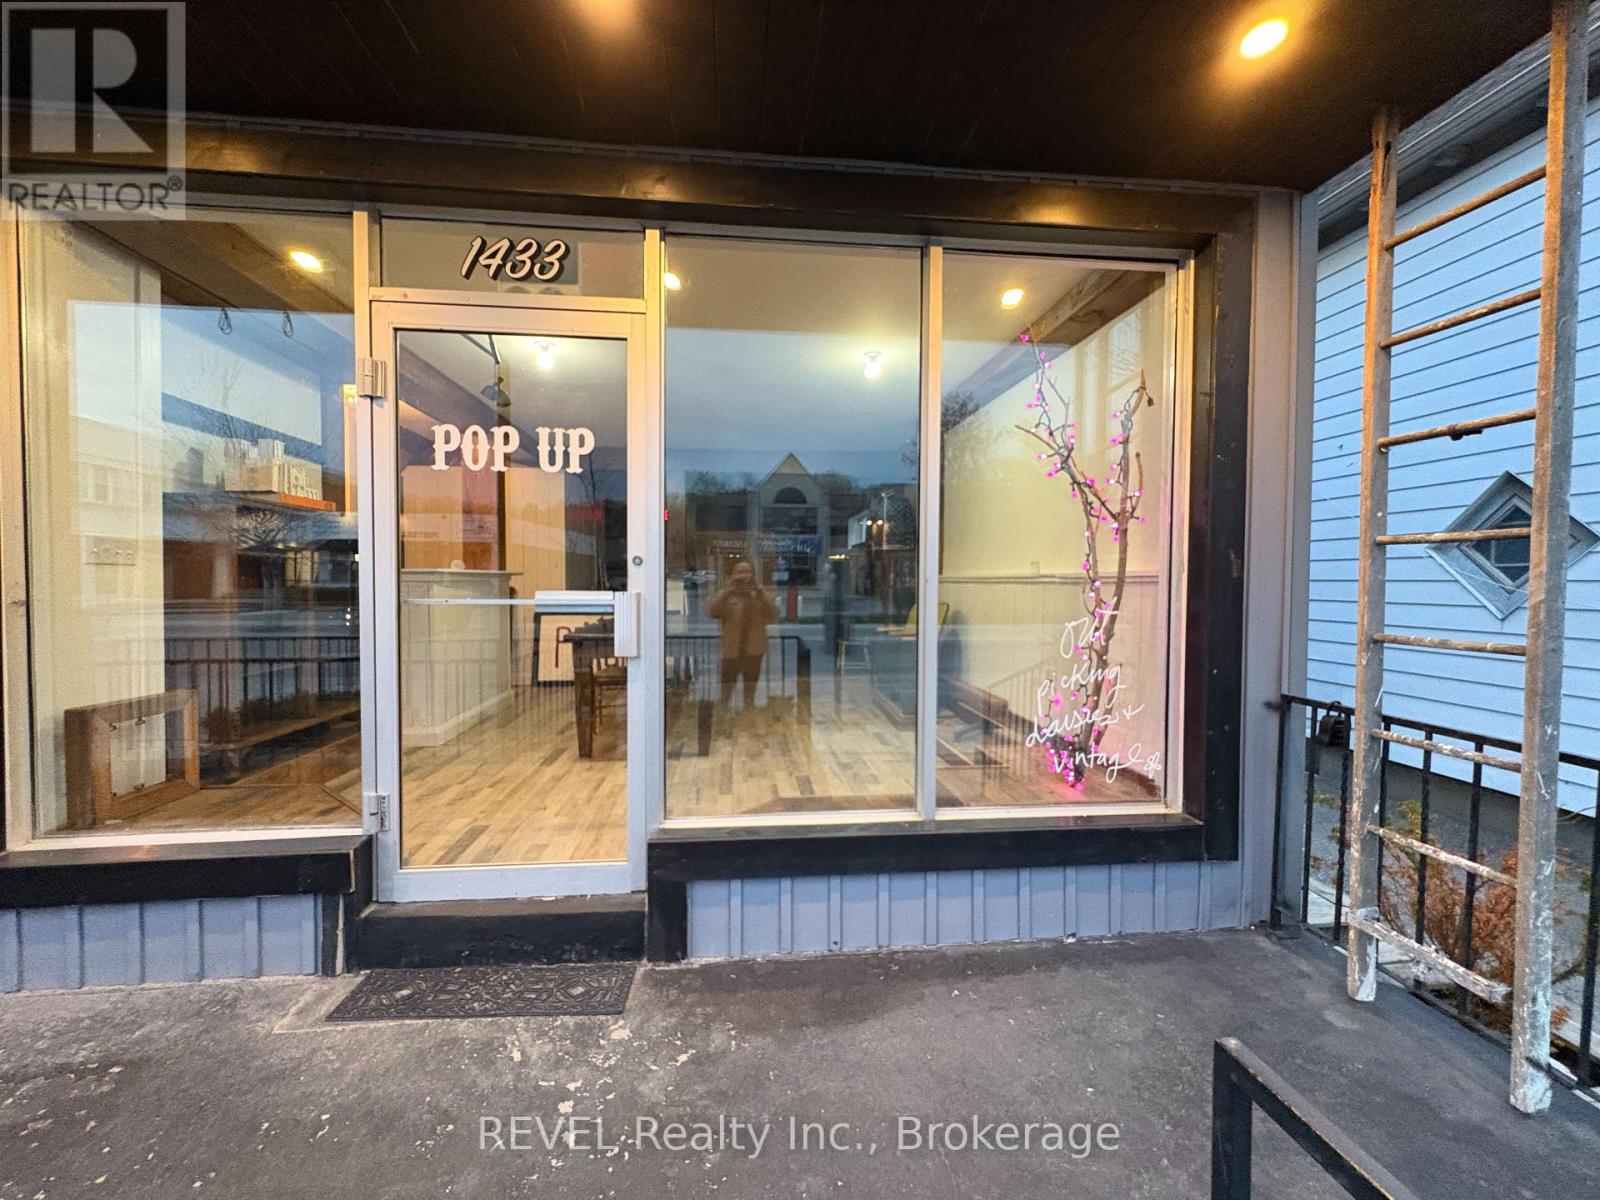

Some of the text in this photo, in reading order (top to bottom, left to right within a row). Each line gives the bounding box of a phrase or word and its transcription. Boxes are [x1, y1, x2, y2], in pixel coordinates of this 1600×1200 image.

[461, 236, 571, 281] 1433
[431, 424, 595, 473] POP UP
